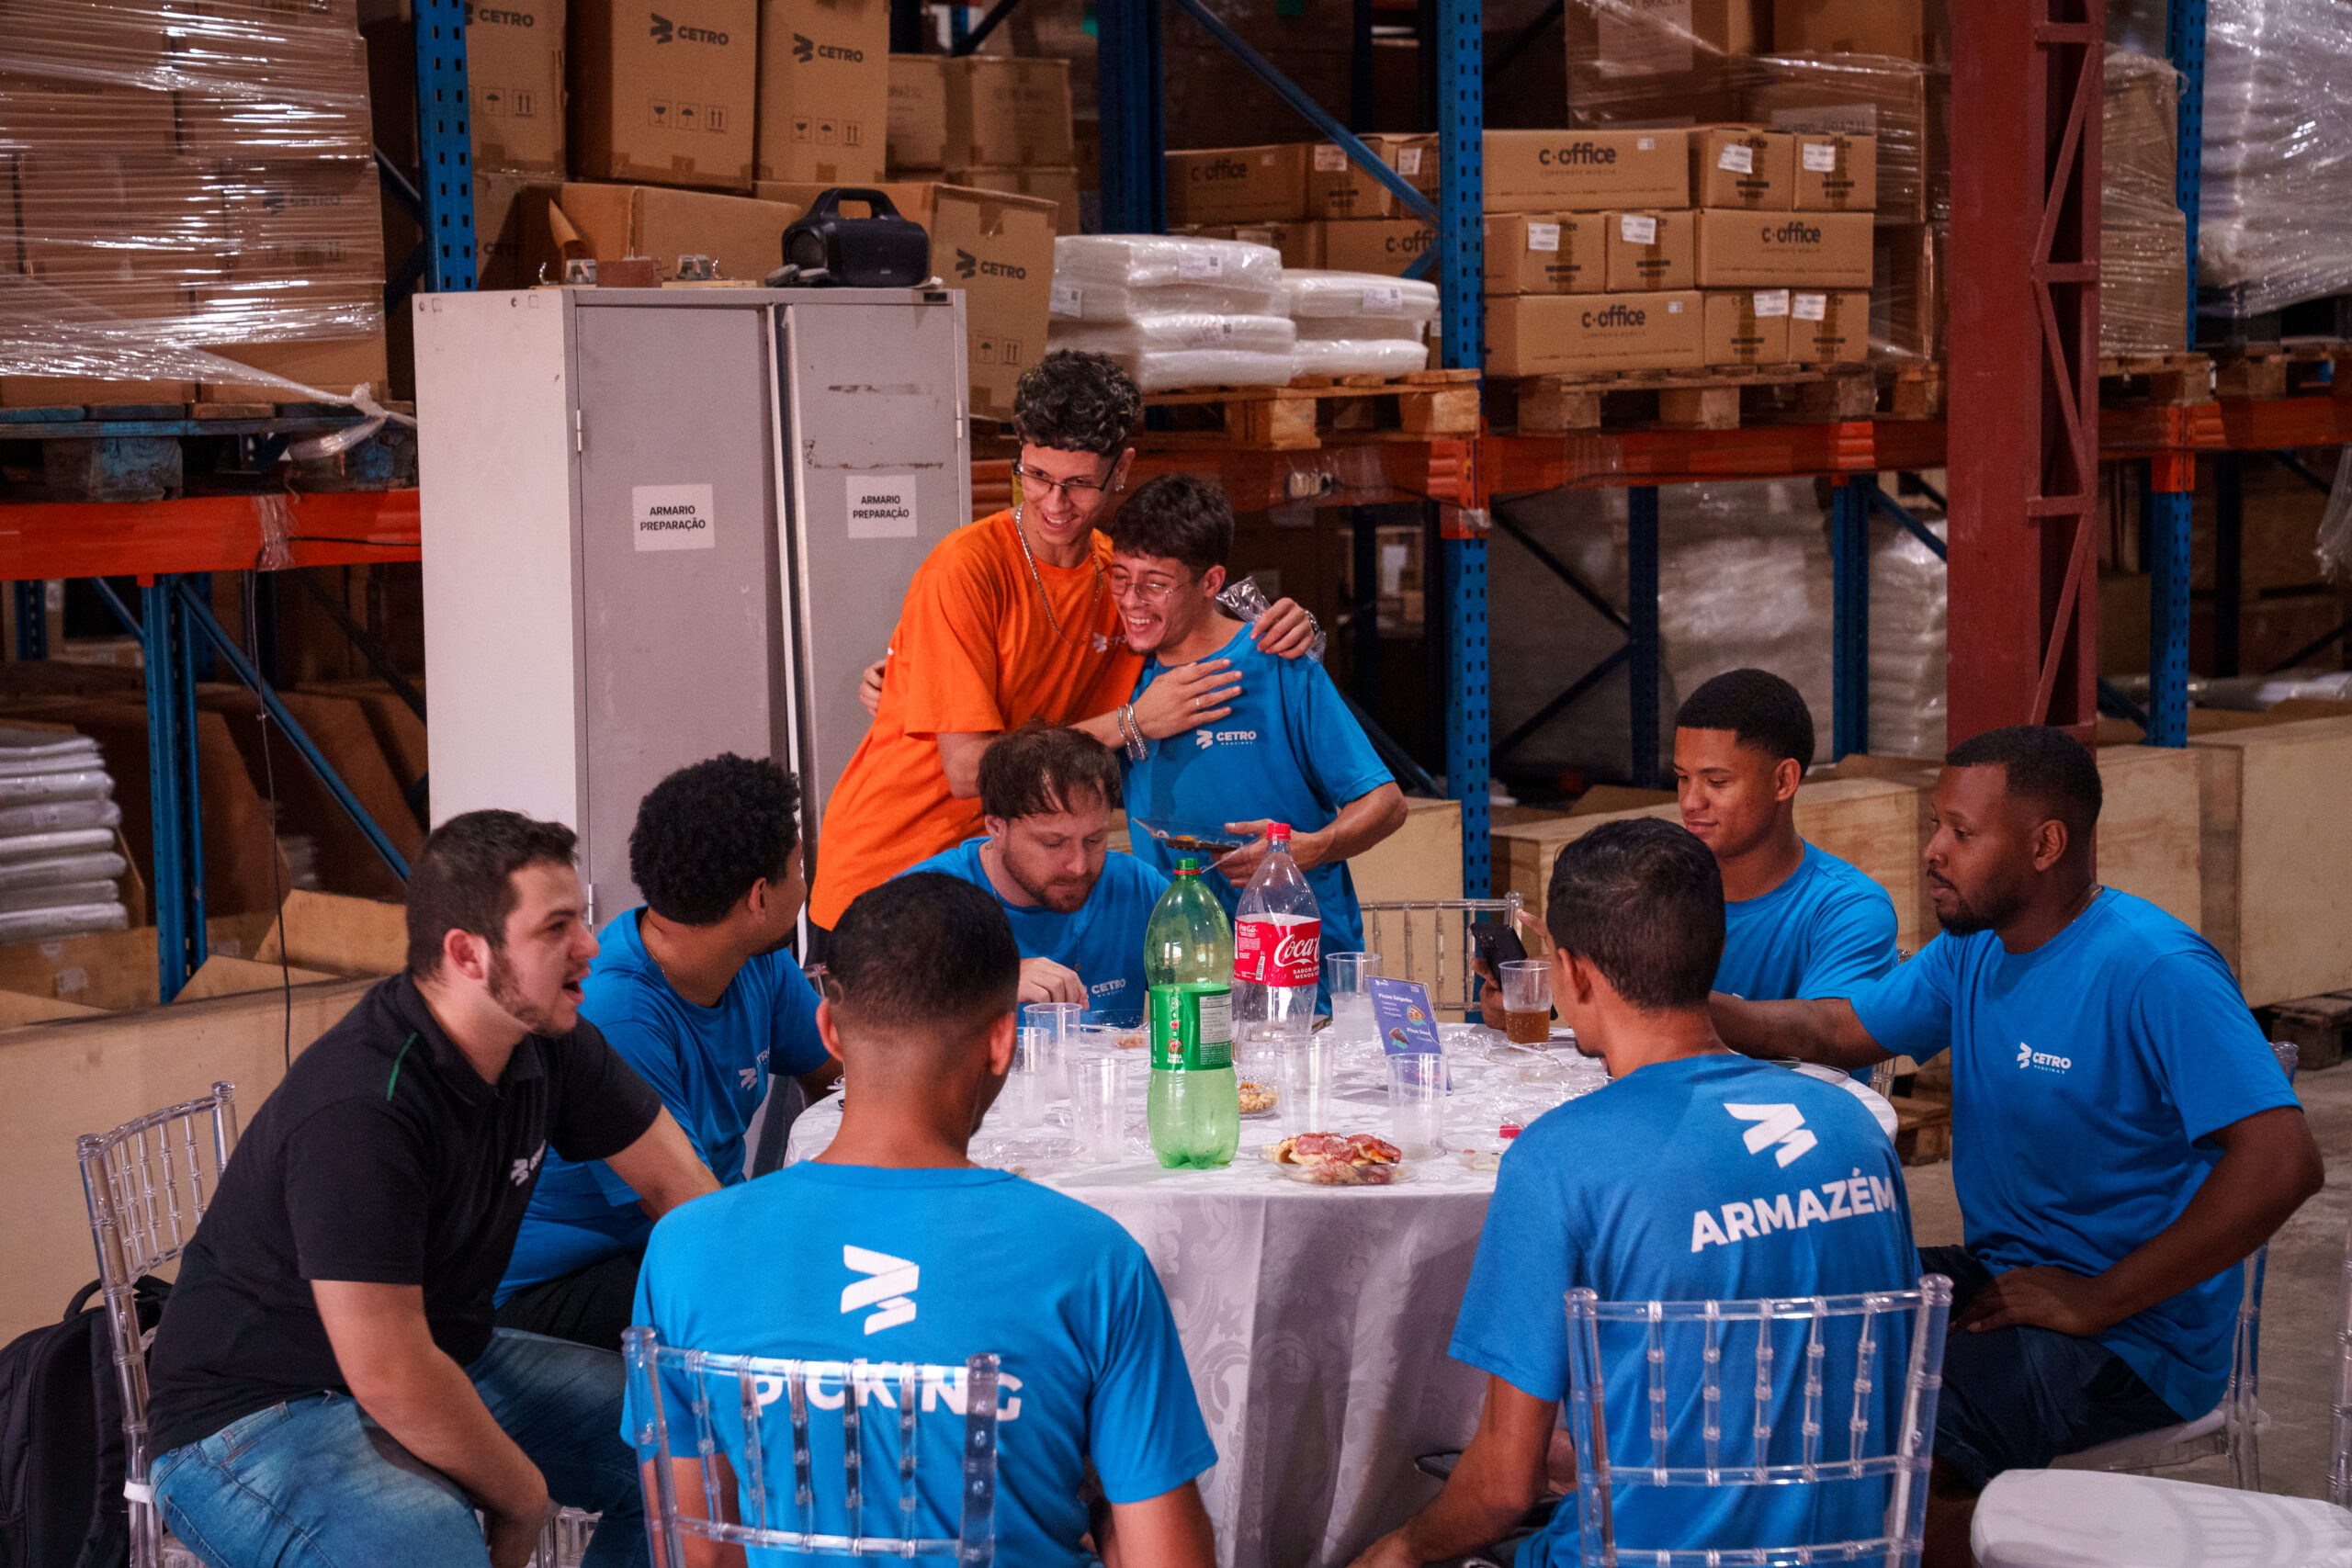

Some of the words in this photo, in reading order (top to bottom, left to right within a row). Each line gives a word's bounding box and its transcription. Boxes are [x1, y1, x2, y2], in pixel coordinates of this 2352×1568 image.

[479, 8, 534, 28] CETRO
[678, 26, 729, 47] CETRO
[818, 44, 864, 63] CETRO
[980, 260, 1027, 279] CETRO
[861, 495, 901, 504] ARMARIO
[650, 505, 695, 515] ARMARIO
[853, 506, 910, 521] PREPARAÇÃO
[640, 517, 706, 531] PREPARAÇÃO
[1216, 730, 1257, 741] CETRO
[1091, 978, 1125, 994] CETRO
[2032, 1052, 2072, 1069] CETRO
[1690, 1167, 1897, 1254] ARMAZÉM
